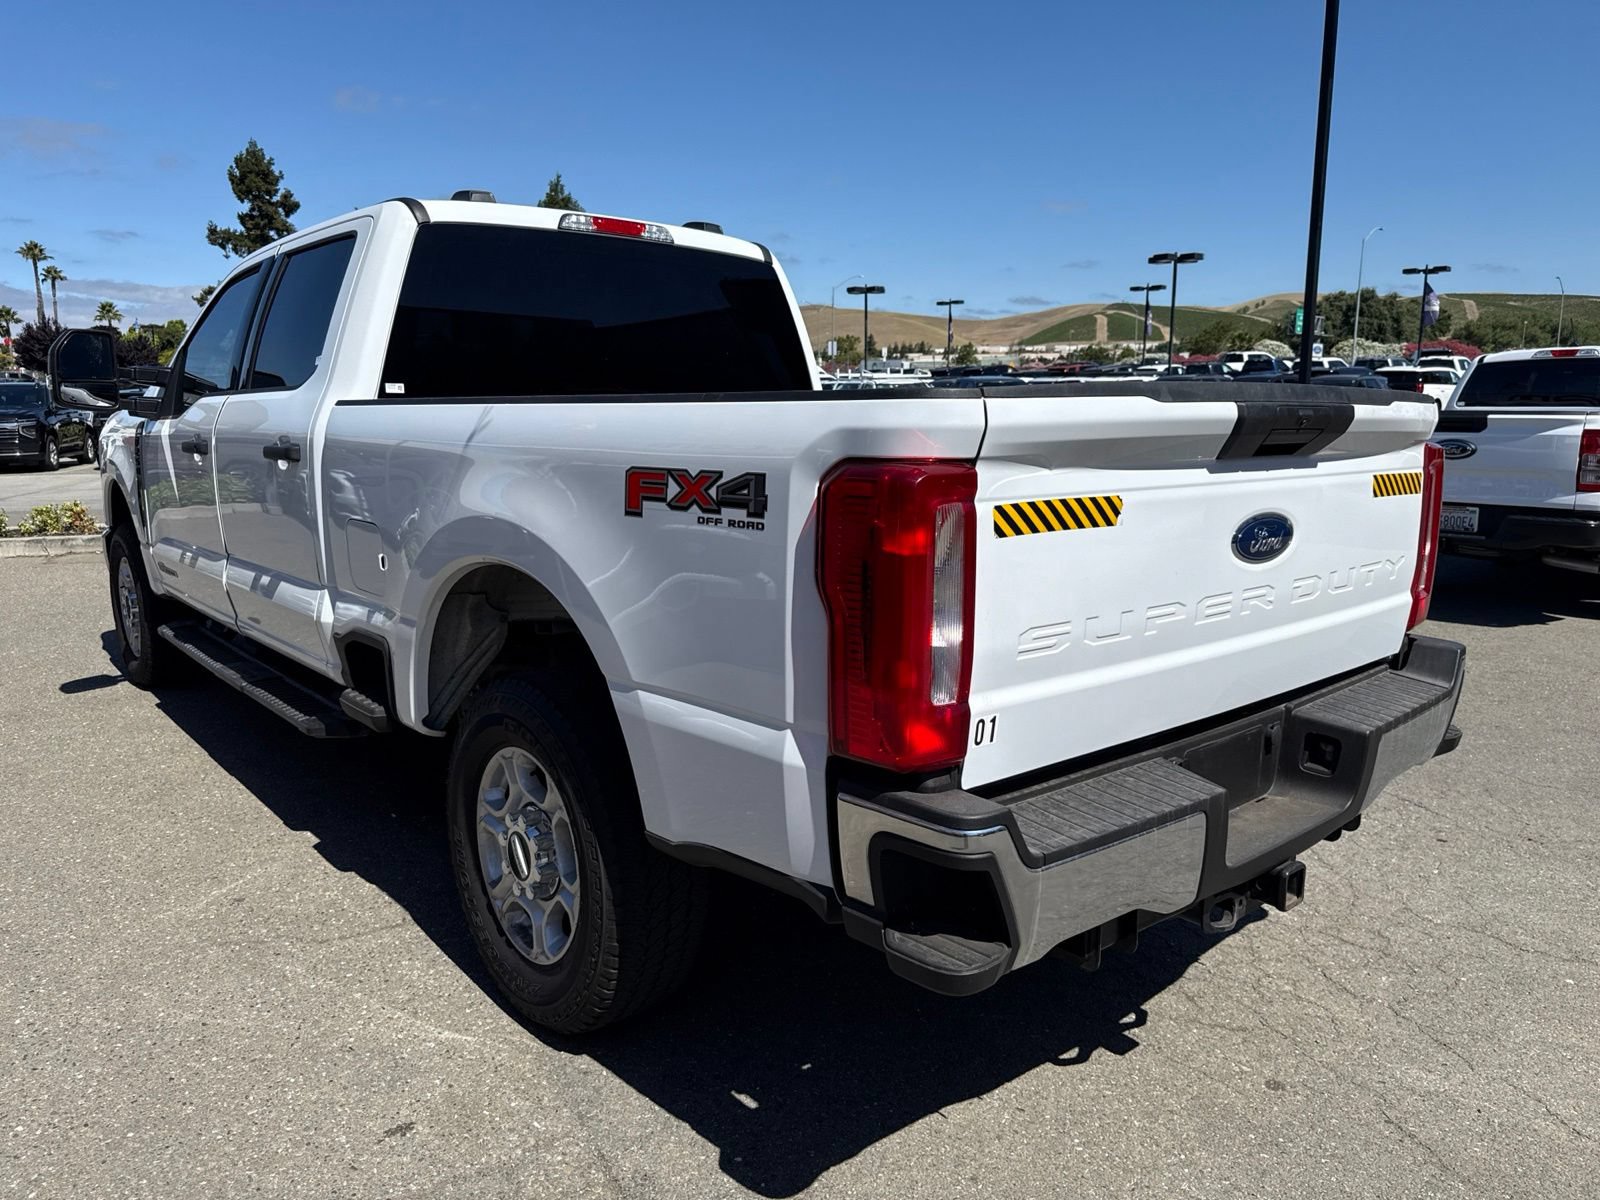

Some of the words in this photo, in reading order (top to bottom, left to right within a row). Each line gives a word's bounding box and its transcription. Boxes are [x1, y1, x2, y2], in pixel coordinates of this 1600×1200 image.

[624, 466, 768, 519] FX4
[697, 516, 724, 527] OFF
[727, 518, 765, 532] ROAD
[1016, 585, 1276, 662] SUPER
[1289, 555, 1405, 605] DUTY
[974, 715, 997, 746] 01
